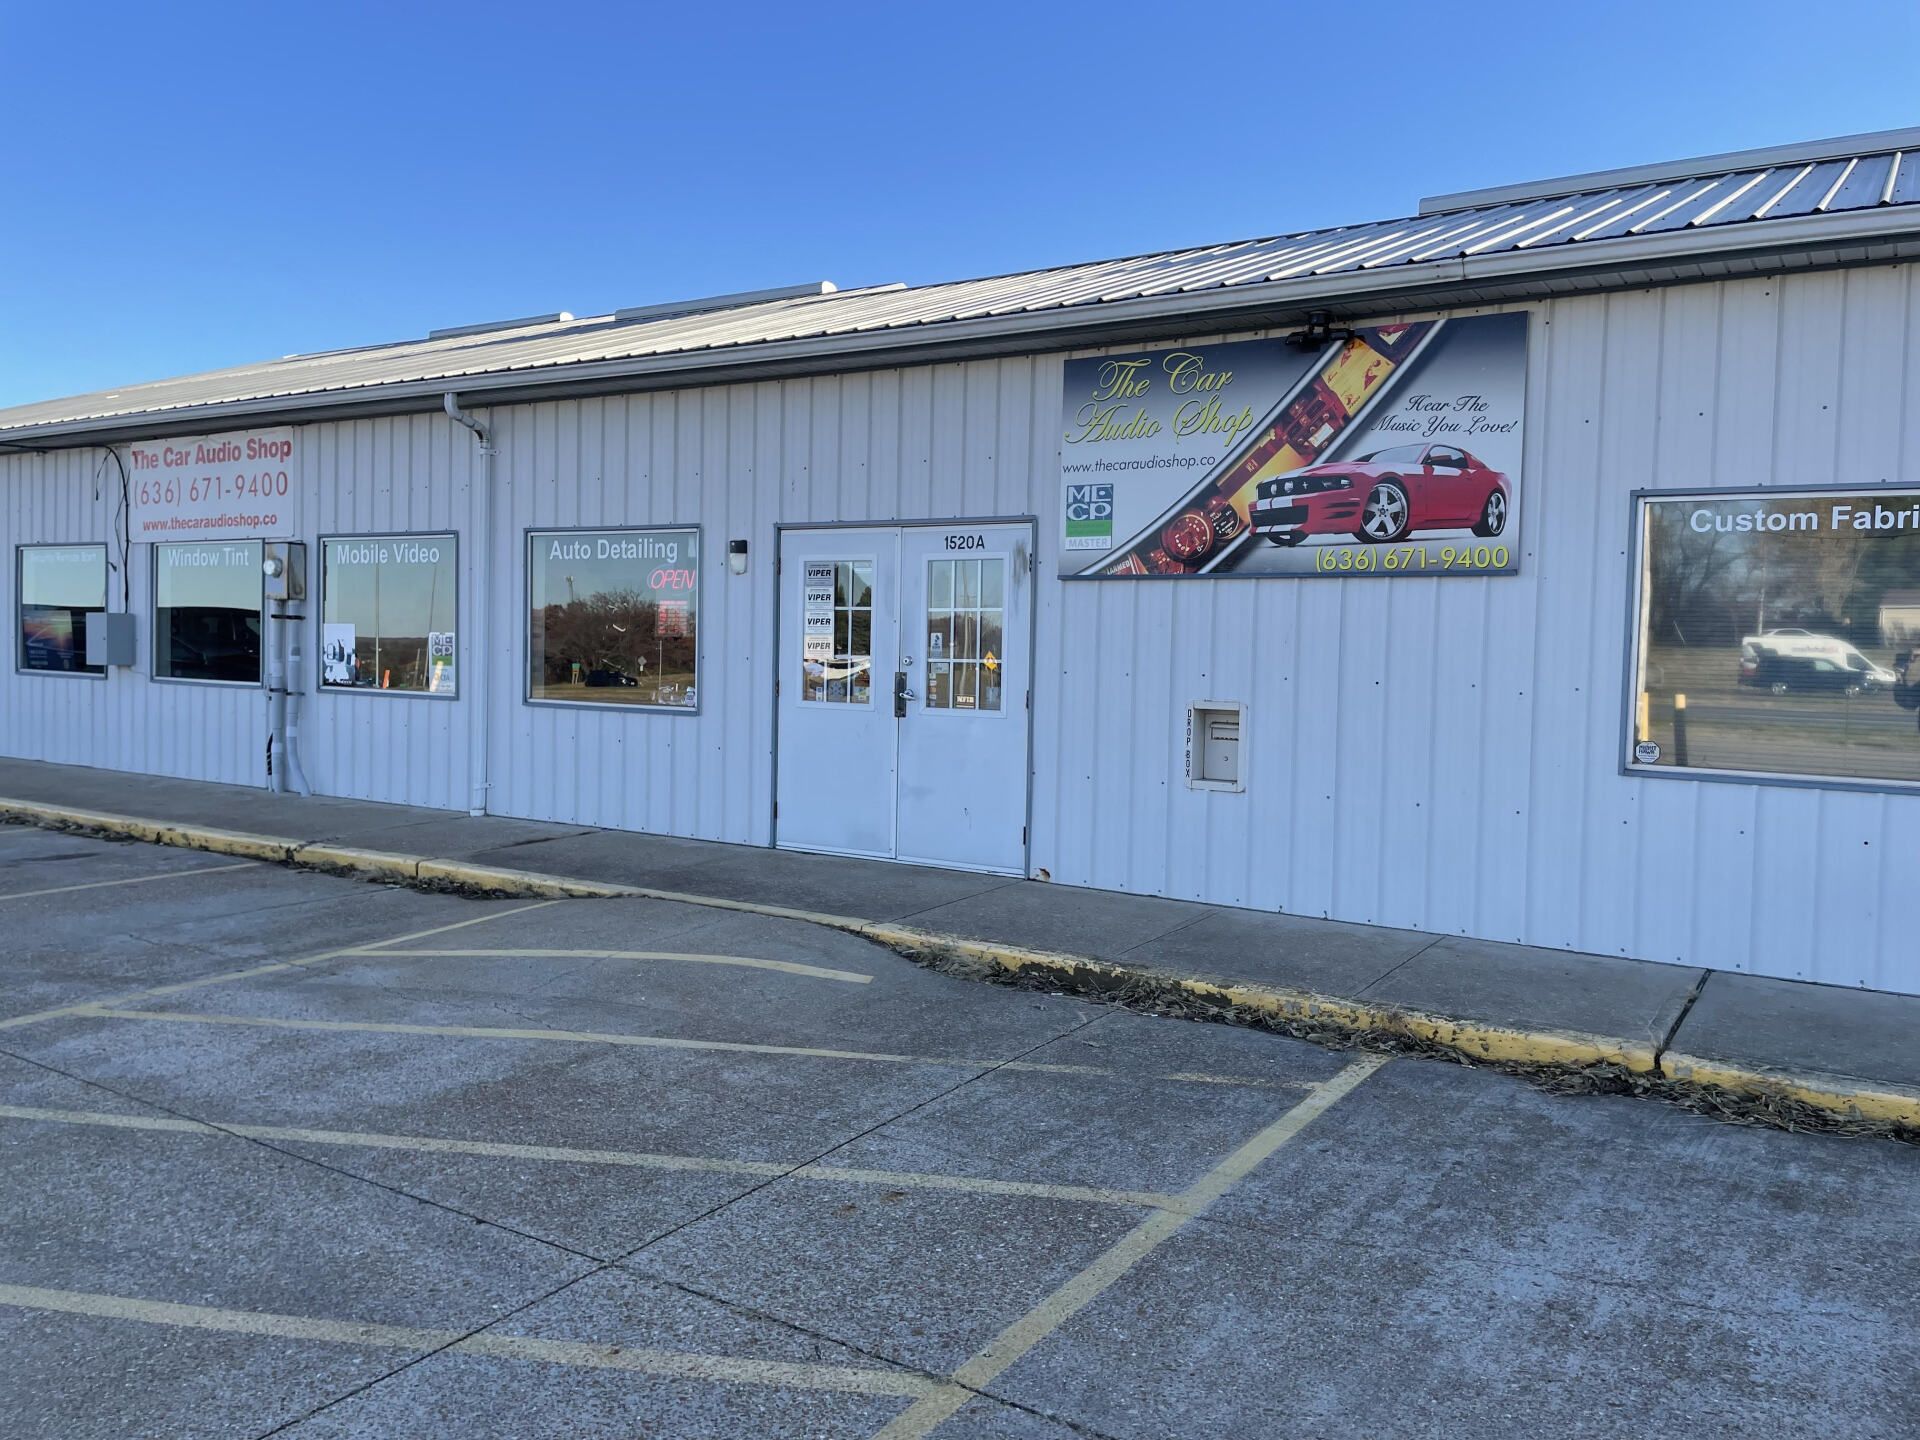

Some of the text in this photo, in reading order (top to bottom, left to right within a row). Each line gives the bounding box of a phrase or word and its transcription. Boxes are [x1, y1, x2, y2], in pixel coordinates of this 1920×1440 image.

[1092, 352, 1233, 401] The Car
[1405, 394, 1490, 412] Hear The
[1064, 393, 1253, 447] Audio Shop
[1371, 414, 1518, 438] Music You Love!
[132, 437, 292, 470] The Car Audio Shop
[1062, 454, 1216, 474] www.thecaraudioshop.co
[134, 471, 288, 509] (636) 671-9400
[143, 513, 277, 531] www.thecaraudioshop.co
[1690, 504, 1920, 533] Custom Fabri
[549, 538, 678, 563] Auto Detailing
[944, 535, 985, 550] 1520A
[1068, 538, 1109, 549] MASTER
[168, 548, 249, 567] Window Tint
[337, 543, 440, 564] Mobile Video
[1315, 546, 1510, 573] (636) 671-9400
[651, 570, 695, 589] OPEN
[808, 569, 831, 577] VIPER
[808, 593, 831, 601] VIPER
[807, 642, 831, 650] VIPER
